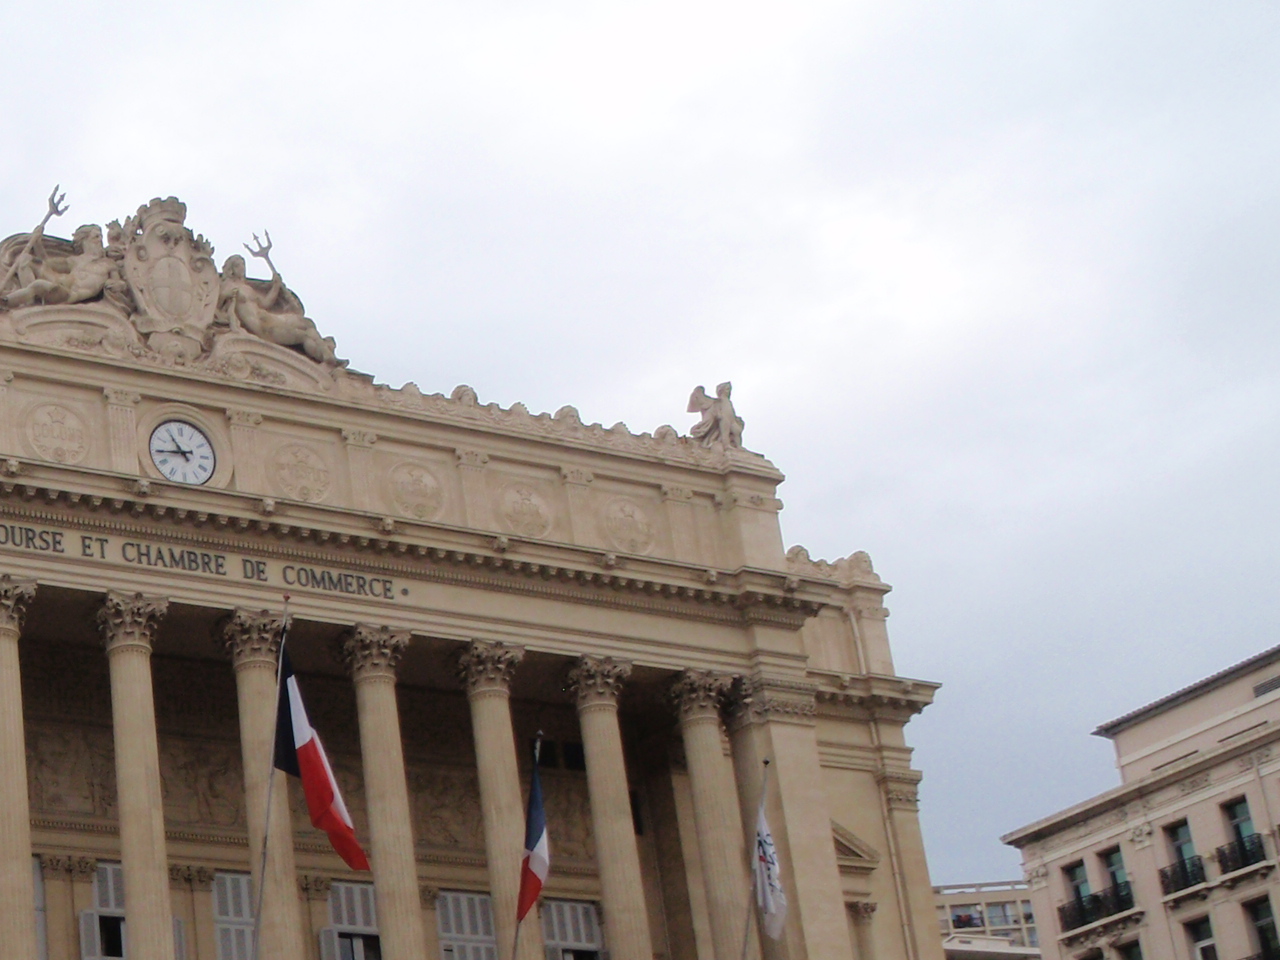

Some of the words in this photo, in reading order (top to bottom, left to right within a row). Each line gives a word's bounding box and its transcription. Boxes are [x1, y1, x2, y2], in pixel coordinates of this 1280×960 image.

[81, 535, 108, 559] ET
[122, 541, 227, 576] CHAMBRE
[242, 558, 268, 582] DE
[283, 565, 395, 600] COMMERCE
